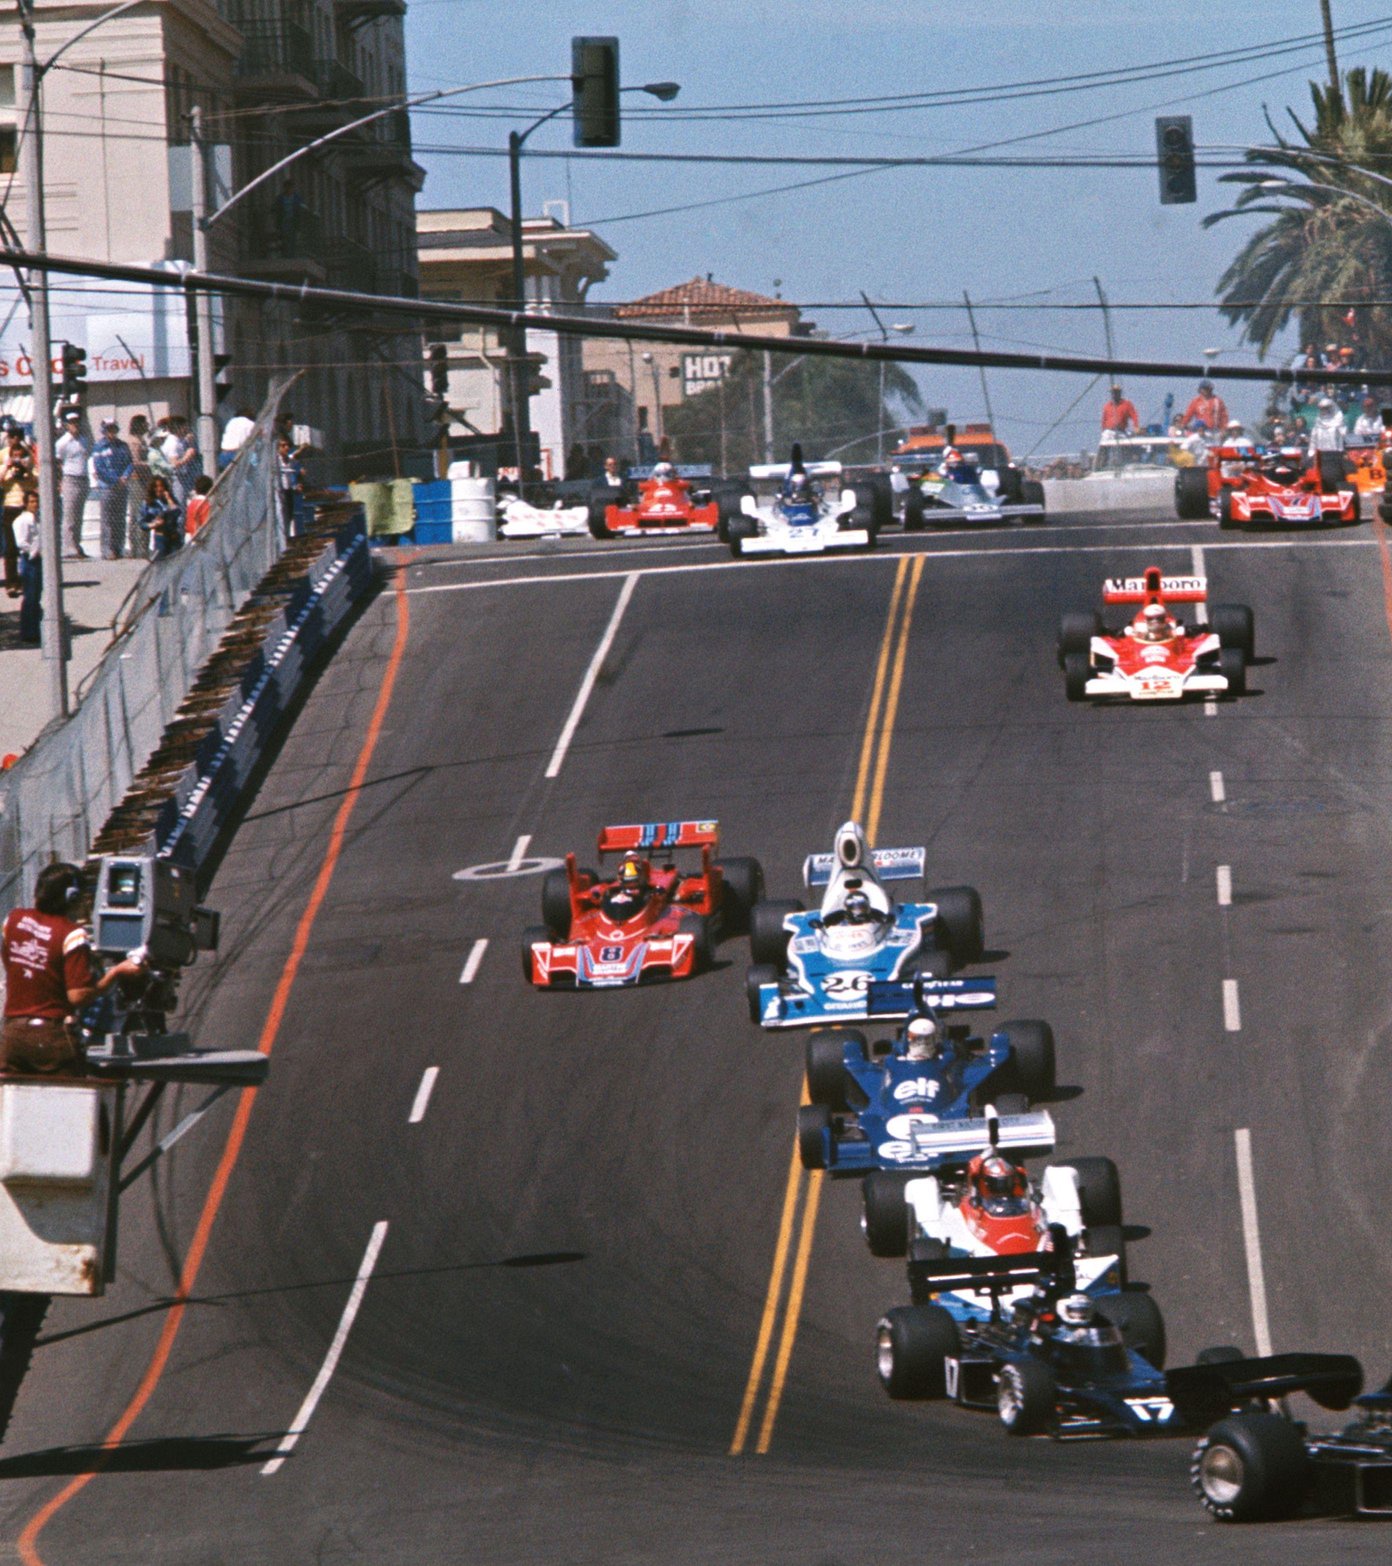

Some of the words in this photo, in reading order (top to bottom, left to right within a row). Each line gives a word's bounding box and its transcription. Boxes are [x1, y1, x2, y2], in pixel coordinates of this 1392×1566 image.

[91, 354, 145, 371] Travel
[1142, 681, 1172, 691] 12
[603, 947, 622, 961] 8
[823, 974, 873, 993] 26
[893, 1077, 940, 1100] elf
[1123, 1397, 1174, 1421] 17
